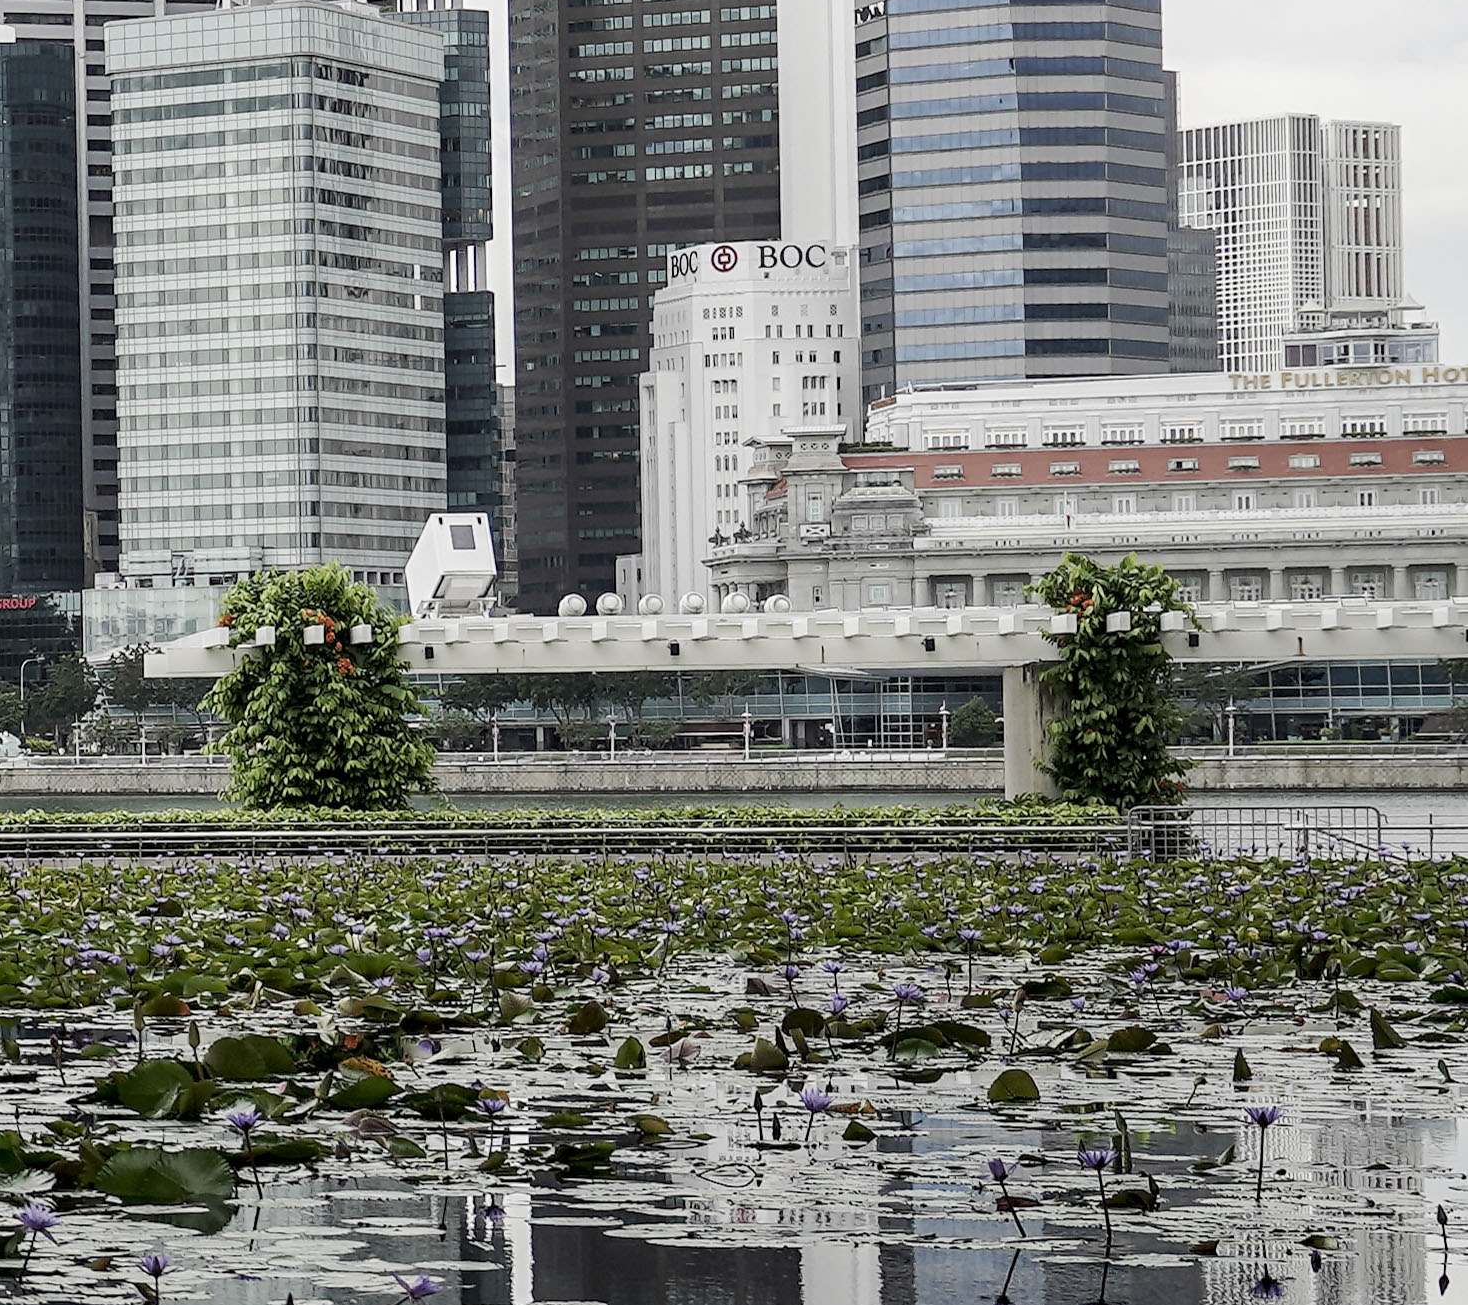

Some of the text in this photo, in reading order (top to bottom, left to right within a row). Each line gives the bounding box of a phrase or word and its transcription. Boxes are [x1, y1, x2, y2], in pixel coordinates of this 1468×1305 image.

[671, 250, 698, 278] BOC
[757, 245, 827, 269] BOC
[1228, 373, 1272, 390] THE
[1281, 368, 1412, 389] FULLERTON
